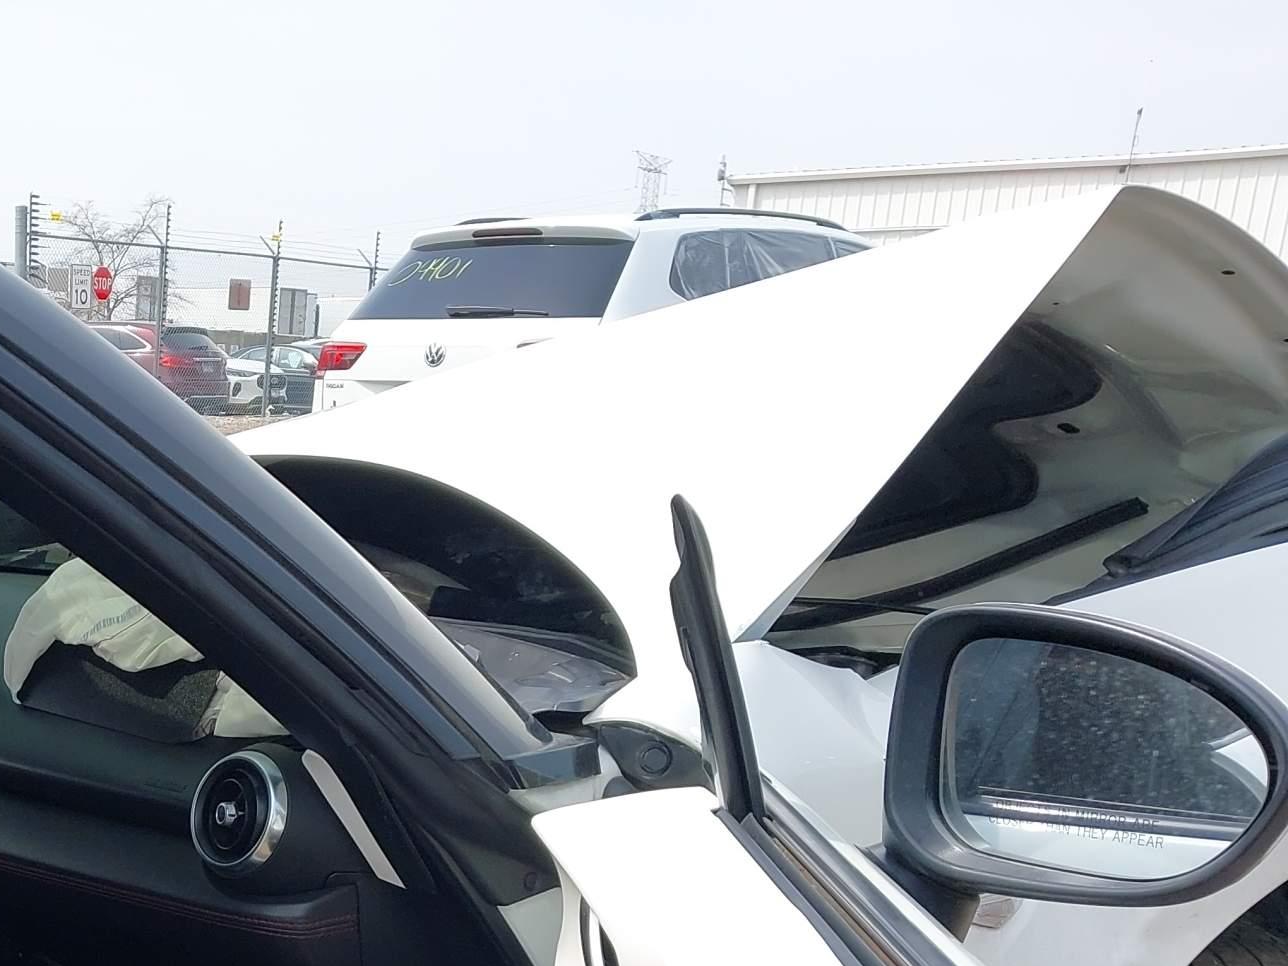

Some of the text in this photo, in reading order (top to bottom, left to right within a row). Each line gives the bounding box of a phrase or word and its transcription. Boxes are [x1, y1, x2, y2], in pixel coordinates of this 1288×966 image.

[73, 268, 90, 277] SPEED
[93, 277, 112, 290] STOP
[75, 289, 88, 305] 10
[1041, 820, 1071, 836] HAN
[1077, 825, 1108, 840] THEY
[1112, 830, 1165, 848] APPEAR
